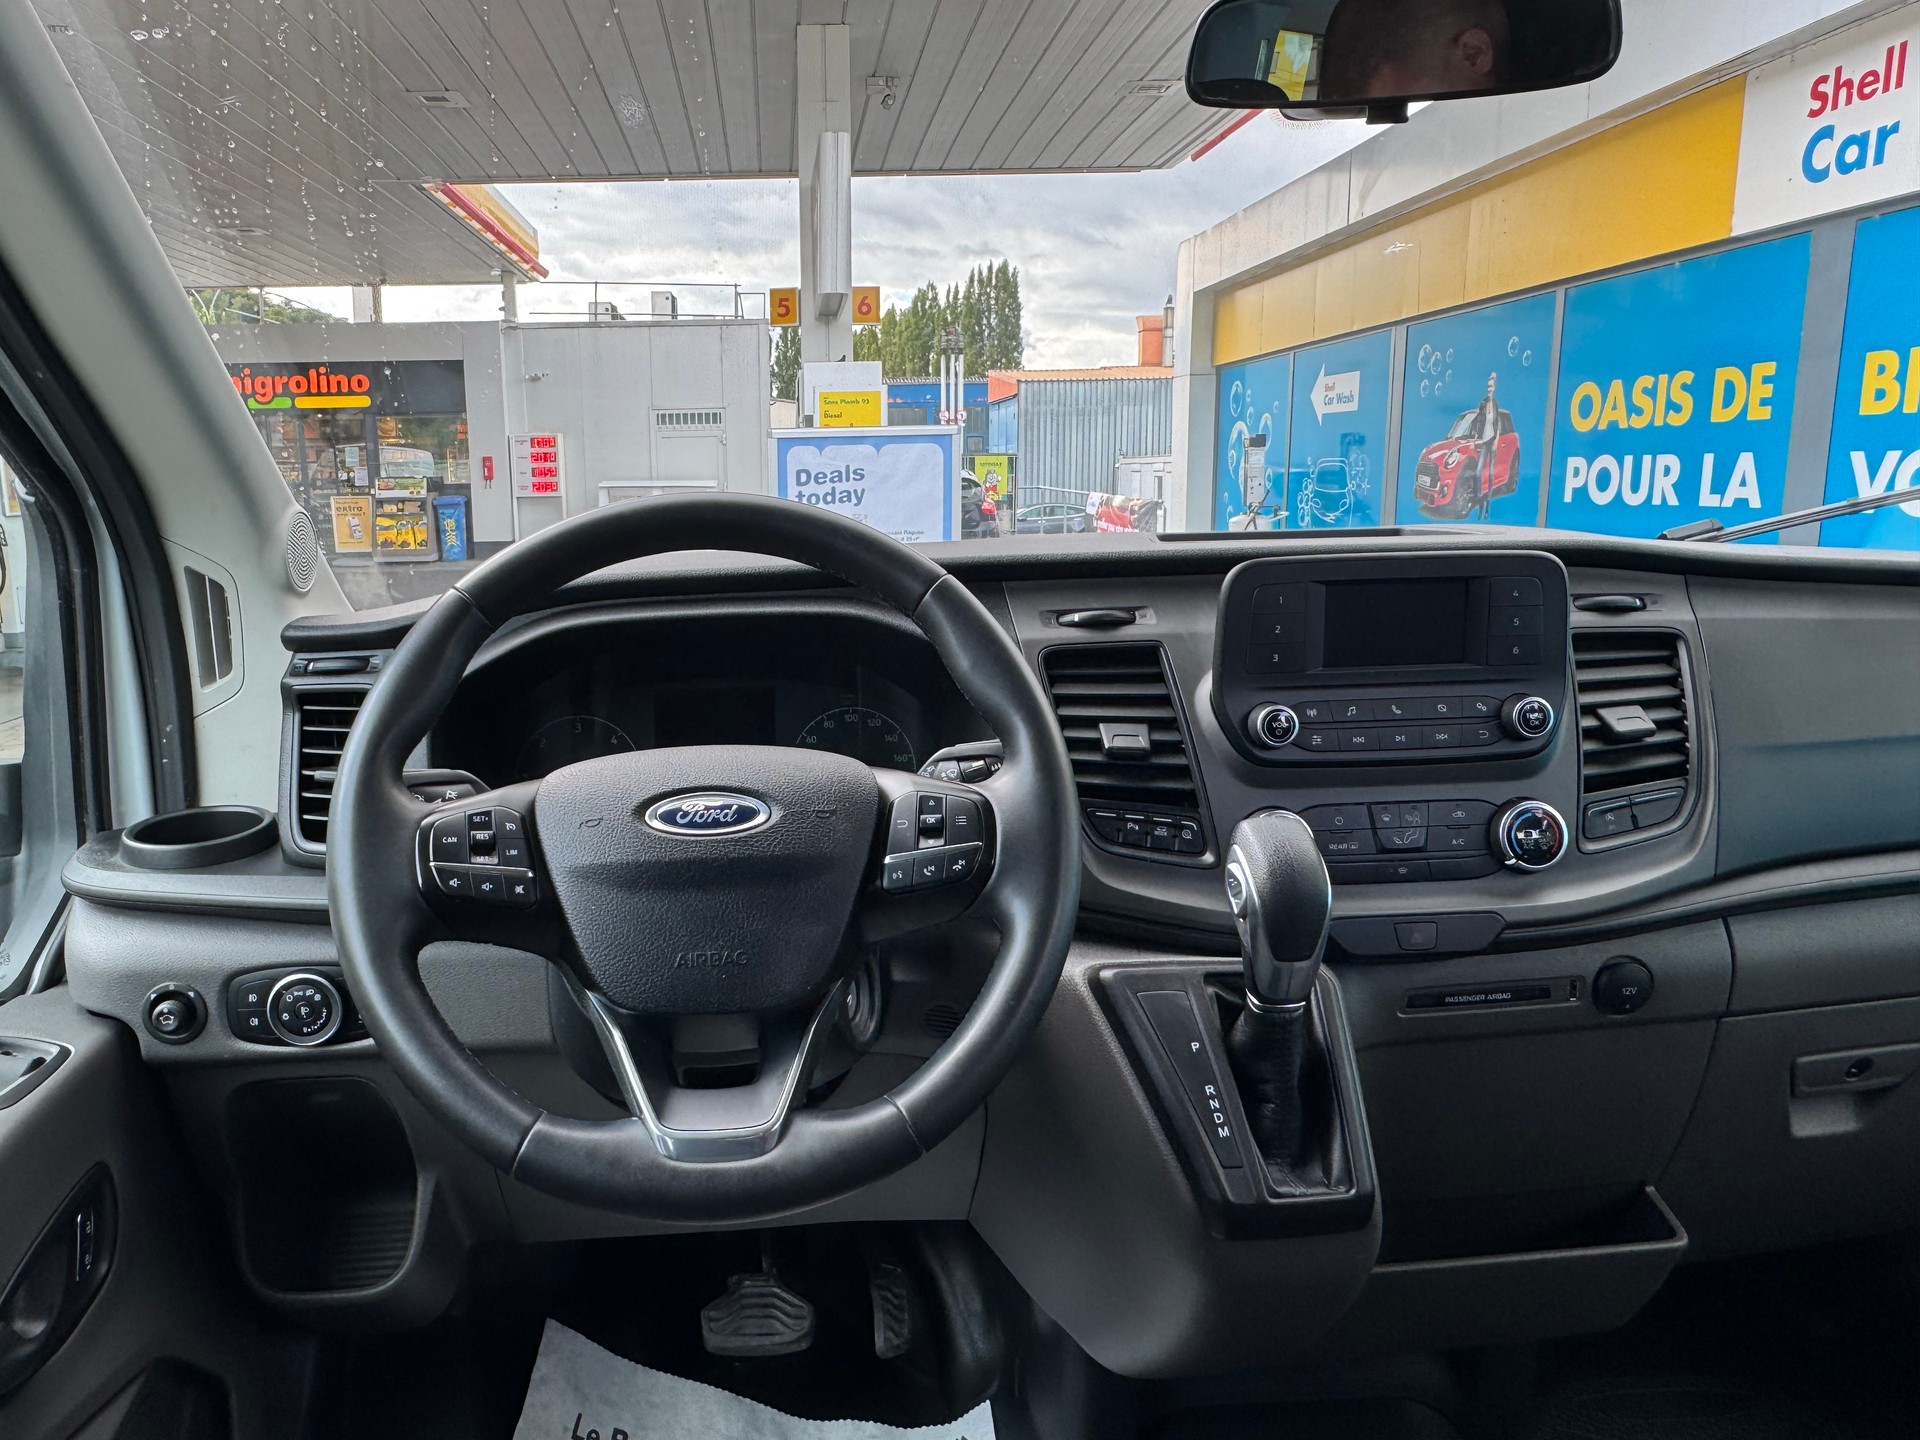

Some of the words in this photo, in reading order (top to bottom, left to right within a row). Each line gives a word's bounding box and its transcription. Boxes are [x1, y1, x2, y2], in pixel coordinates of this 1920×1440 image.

[1807, 40, 1908, 119] Shell
[1801, 119, 1901, 184] Car
[777, 297, 791, 318] 5
[857, 295, 872, 315] 6
[1324, 394, 1334, 406] Car
[1336, 390, 1354, 404] Wash
[1570, 371, 1694, 432] OASIS
[1710, 362, 1776, 423] DE
[795, 464, 866, 487] Deals
[1563, 454, 1681, 507] POUR
[1699, 451, 1762, 509] LA
[795, 485, 866, 507] today
[844, 713, 859, 722] 100
[868, 718, 881, 727] 120
[575, 723, 582, 733] 3
[823, 720, 834, 728] 80
[610, 735, 618, 744] 4
[806, 735, 817, 744] 60
[884, 734, 898, 742] 140
[893, 754, 908, 762] 160
[676, 800, 738, 823] Ford
[673, 951, 748, 969] AIRBAG
[1622, 986, 1638, 996] 12V
[1445, 995, 1486, 1003] PASSENGER
[1487, 992, 1512, 1001] AIRBAG
[1191, 1042, 1200, 1053] P
[1205, 1085, 1216, 1096] R
[1209, 1099, 1220, 1110] N
[1213, 1112, 1224, 1124] D
[1218, 1126, 1230, 1138] M
